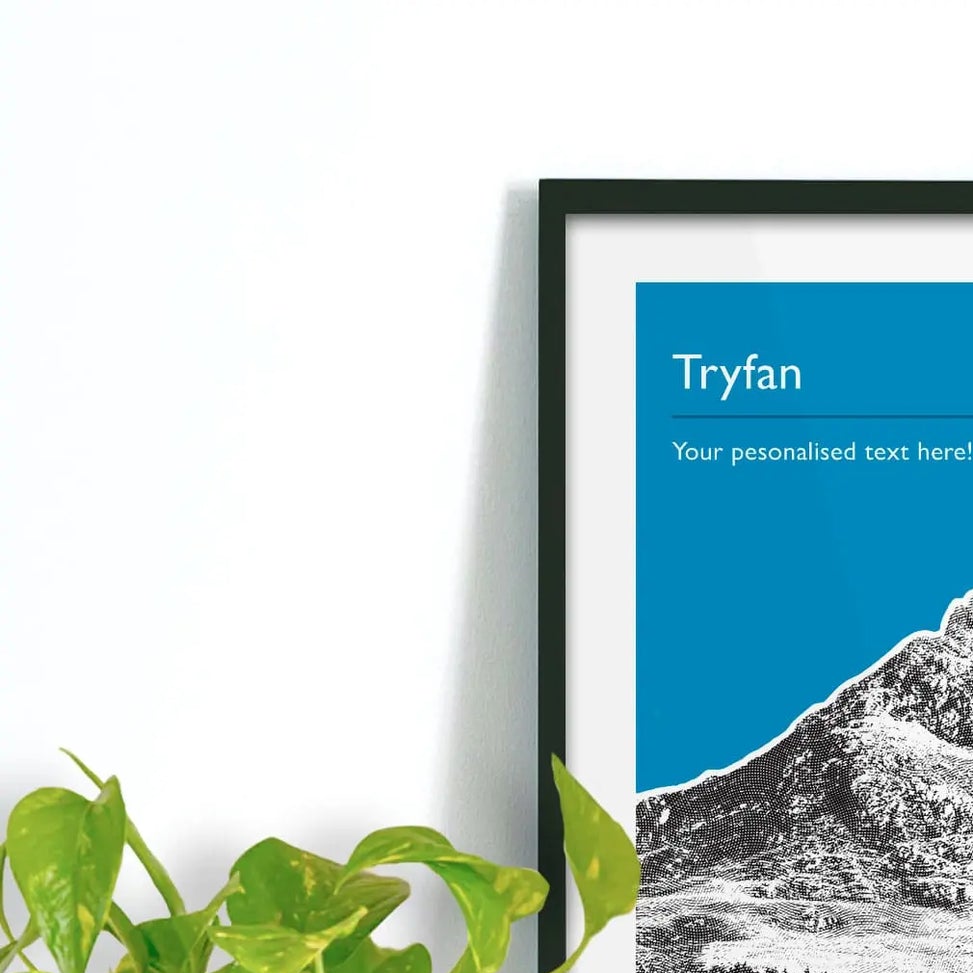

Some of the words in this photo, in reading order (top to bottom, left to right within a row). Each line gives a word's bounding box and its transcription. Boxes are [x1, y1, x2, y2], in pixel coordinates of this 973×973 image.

[672, 353, 801, 401] Tryfan
[672, 441, 724, 461] Your
[731, 441, 856, 466] pesonalised
[864, 446, 910, 461] text
[918, 441, 972, 461] here!
